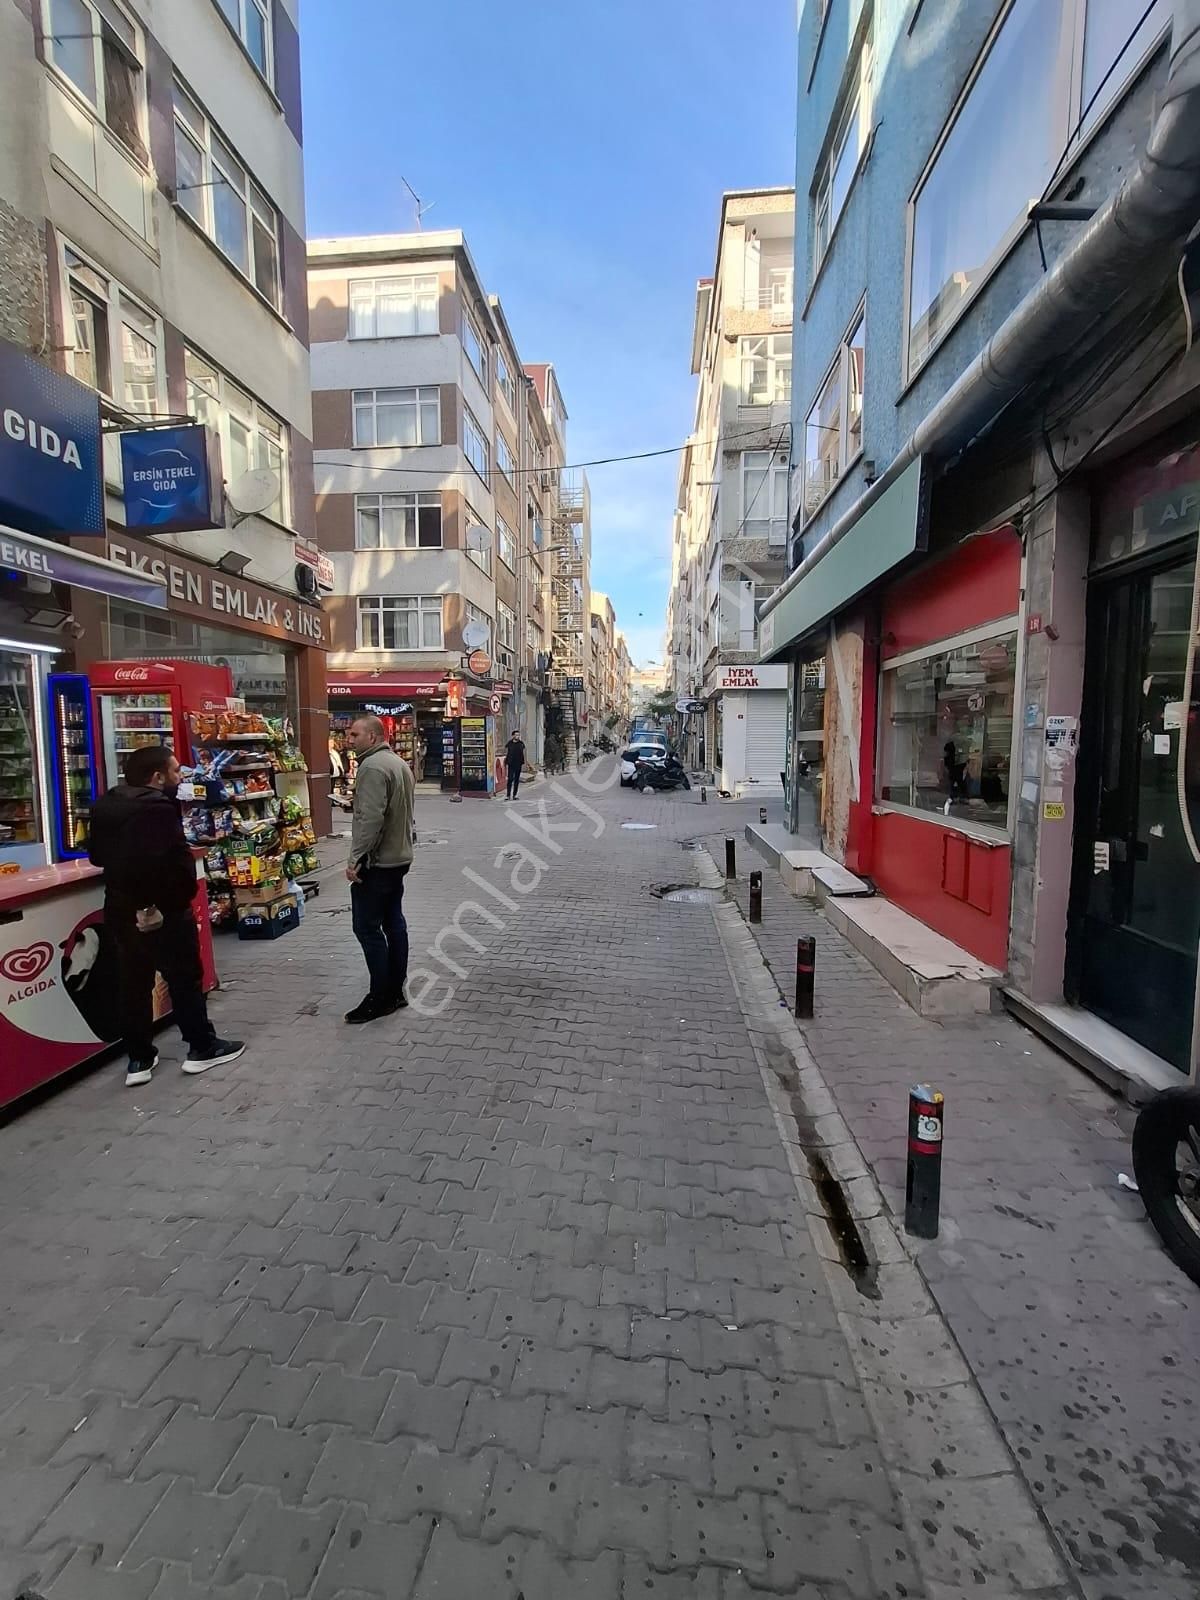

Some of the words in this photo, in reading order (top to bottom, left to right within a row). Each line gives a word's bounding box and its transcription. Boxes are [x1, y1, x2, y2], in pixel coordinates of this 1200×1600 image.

[3, 408, 83, 470] GIDA
[133, 467, 164, 482] ERSİN
[165, 466, 196, 479] TEKEL
[153, 480, 177, 491] GIDA
[211, 580, 279, 627] EMLAK
[283, 608, 294, 631] &
[728, 667, 753, 677] İYEM
[722, 678, 758, 687] EMLAK
